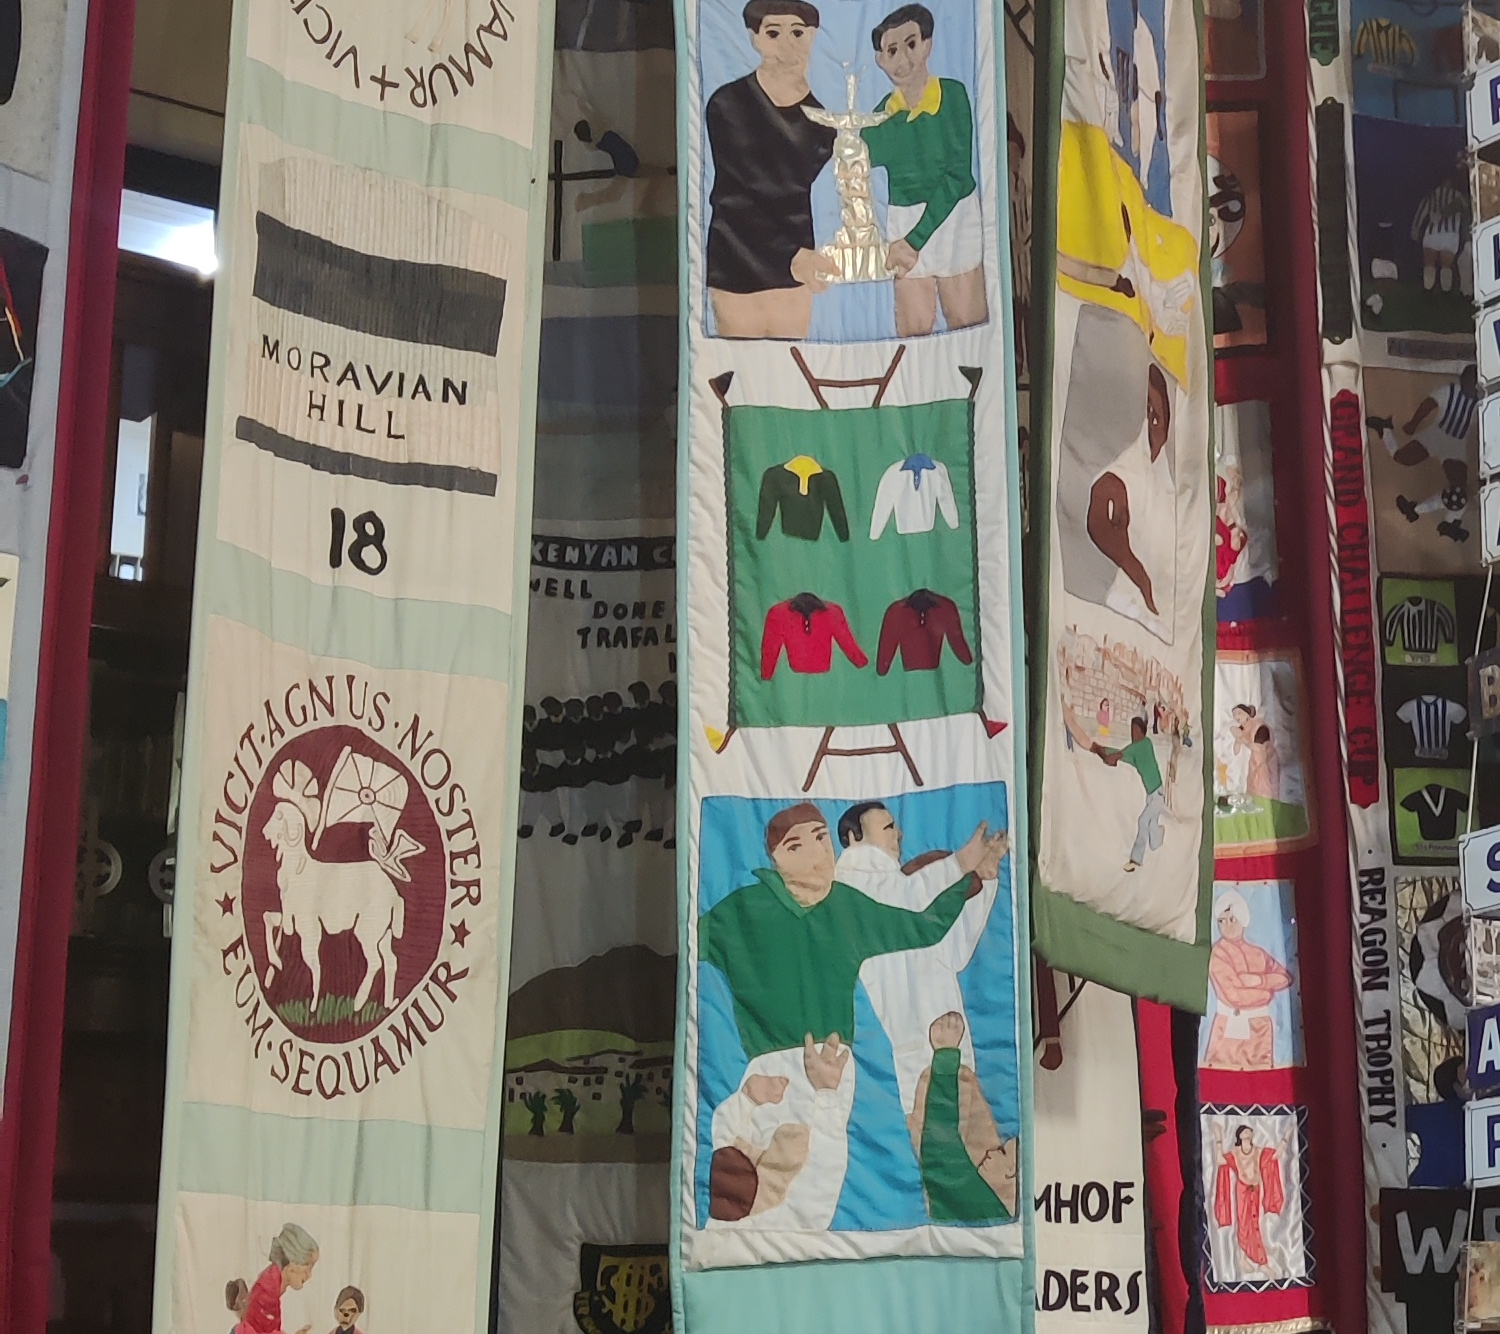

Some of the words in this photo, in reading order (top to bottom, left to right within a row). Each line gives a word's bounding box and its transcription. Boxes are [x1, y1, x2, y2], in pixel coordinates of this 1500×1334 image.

[261, 334, 468, 406] MORAVIAN
[307, 390, 405, 439] HILL
[329, 507, 388, 576] 18
[592, 600, 665, 620] DONE
[1364, 1010, 1396, 1129] TROPHY
[1034, 1269, 1143, 1315] DERS
